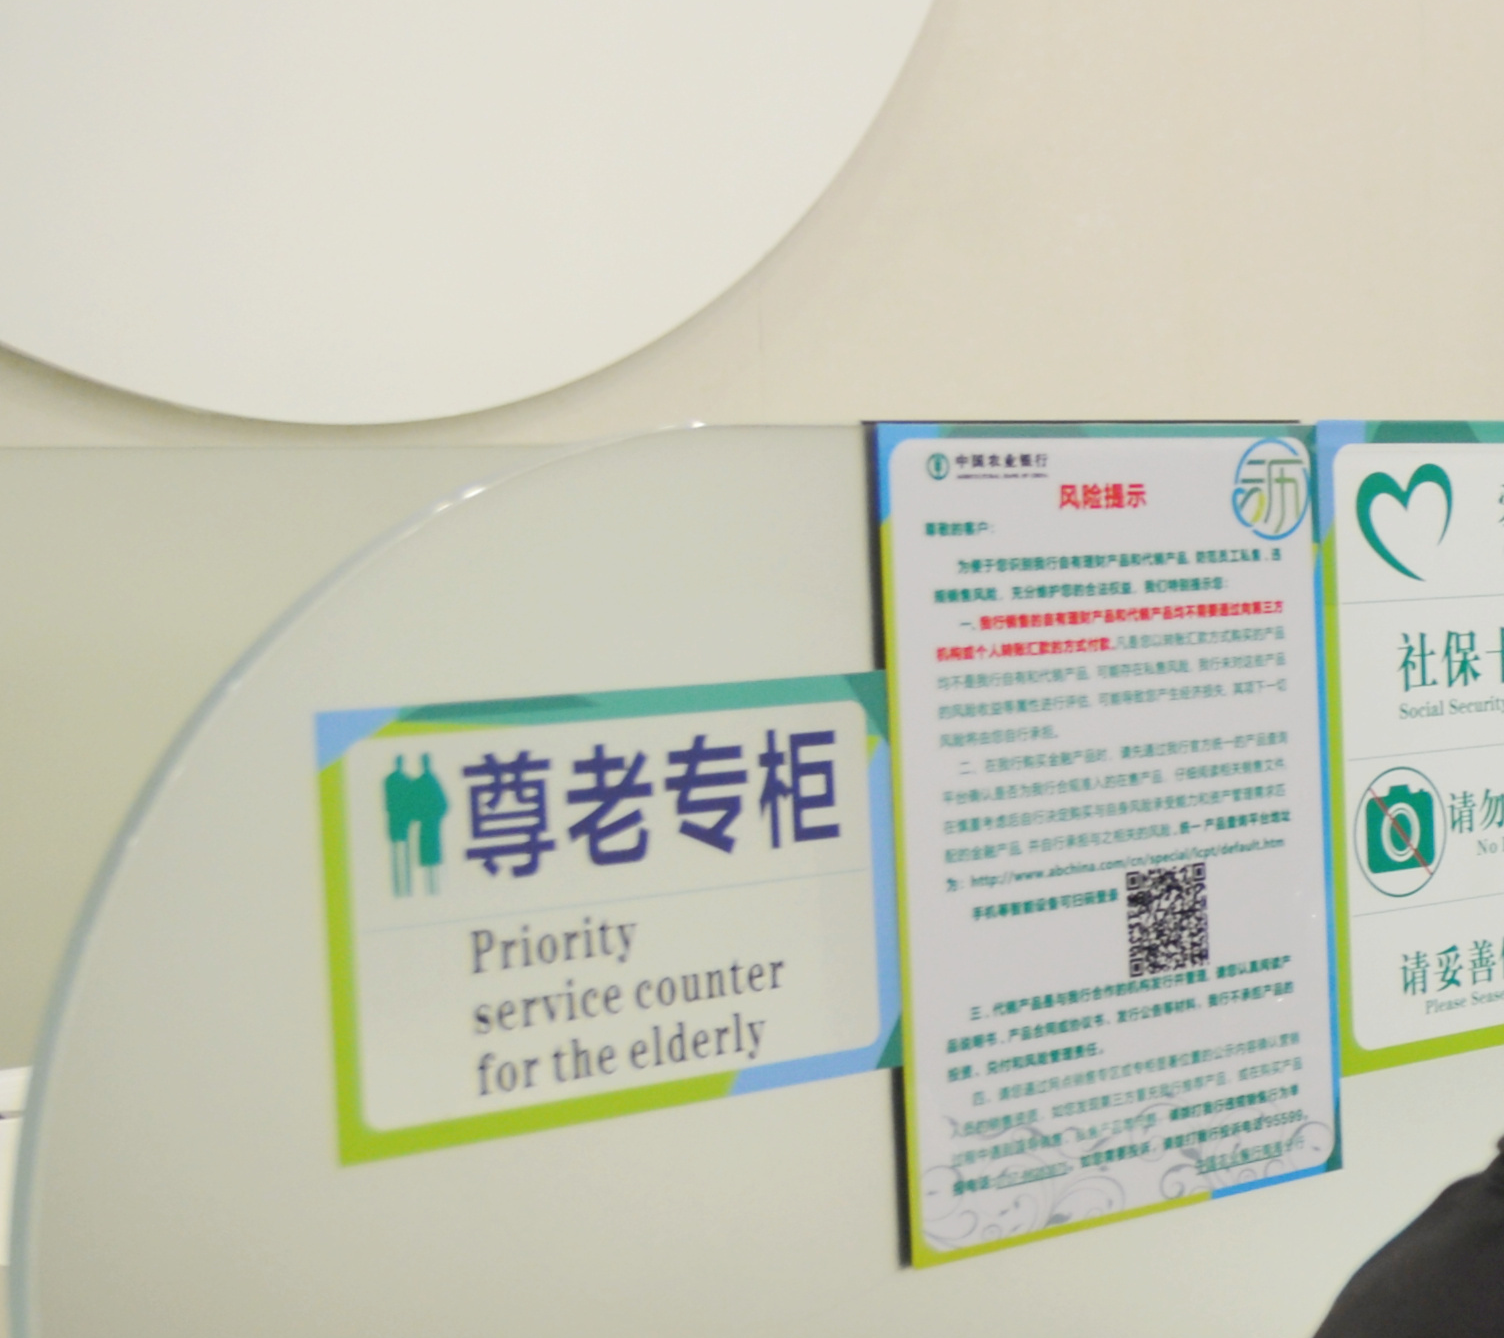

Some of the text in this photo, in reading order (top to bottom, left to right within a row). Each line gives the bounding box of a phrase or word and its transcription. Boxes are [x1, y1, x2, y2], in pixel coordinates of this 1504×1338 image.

[955, 453, 1049, 469] 中国农业银行
[1059, 483, 1147, 510] 风险提示
[1399, 701, 1444, 720] Social
[462, 728, 841, 878] 尊老专柜
[1477, 839, 1497, 856] No
[471, 917, 637, 974] Priority
[474, 960, 785, 1033] service counter
[1425, 997, 1466, 1015] Please
[478, 1013, 765, 1096] for the elderly
